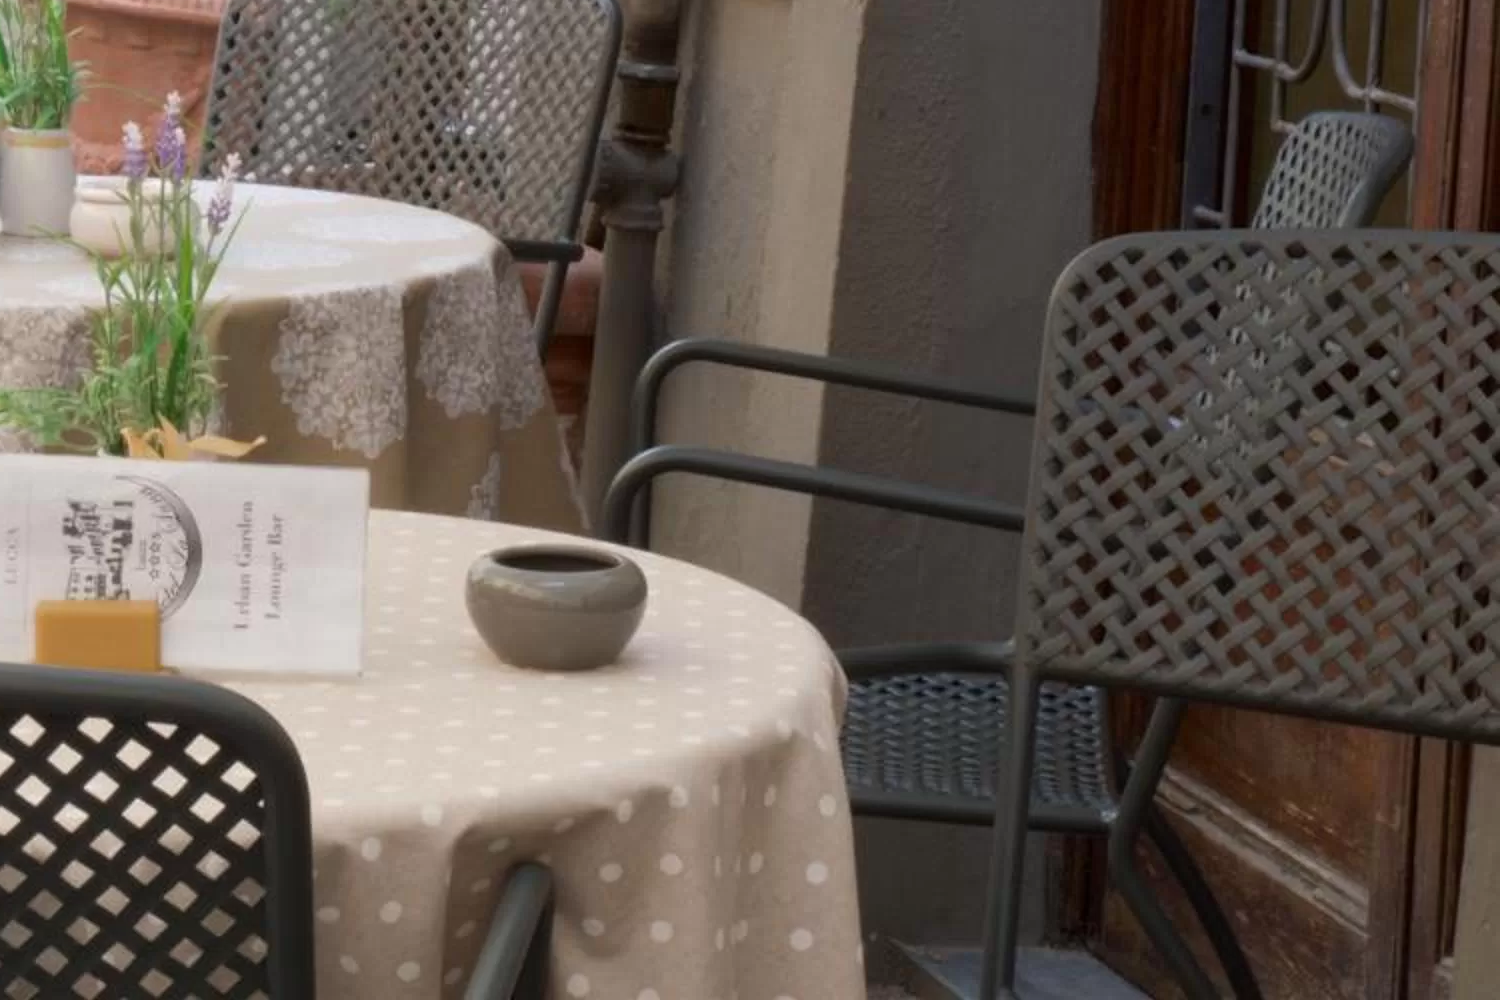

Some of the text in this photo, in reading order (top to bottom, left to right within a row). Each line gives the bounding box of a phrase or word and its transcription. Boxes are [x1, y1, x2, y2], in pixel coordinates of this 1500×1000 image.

[3, 527, 20, 585] LUCCA
[234, 500, 254, 631] Urban Garden
[264, 514, 285, 620] Lounge Bar
